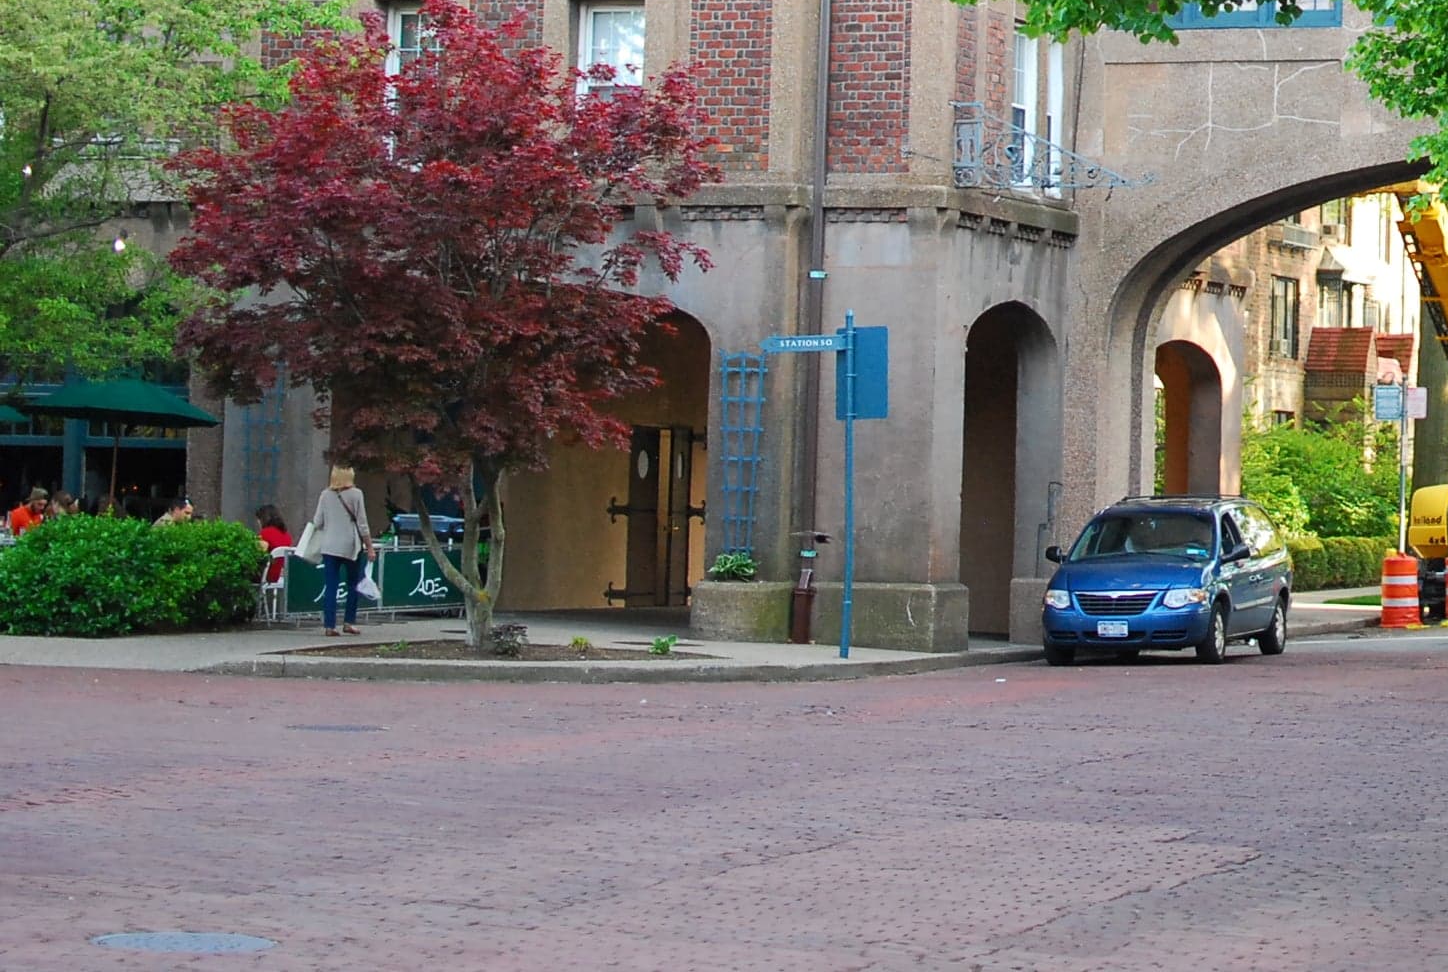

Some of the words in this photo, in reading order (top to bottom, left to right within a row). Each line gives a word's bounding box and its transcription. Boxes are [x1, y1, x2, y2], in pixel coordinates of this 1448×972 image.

[780, 339, 818, 347] STATION
[1429, 536, 1446, 544] 4x4
[408, 558, 448, 596] JADE
